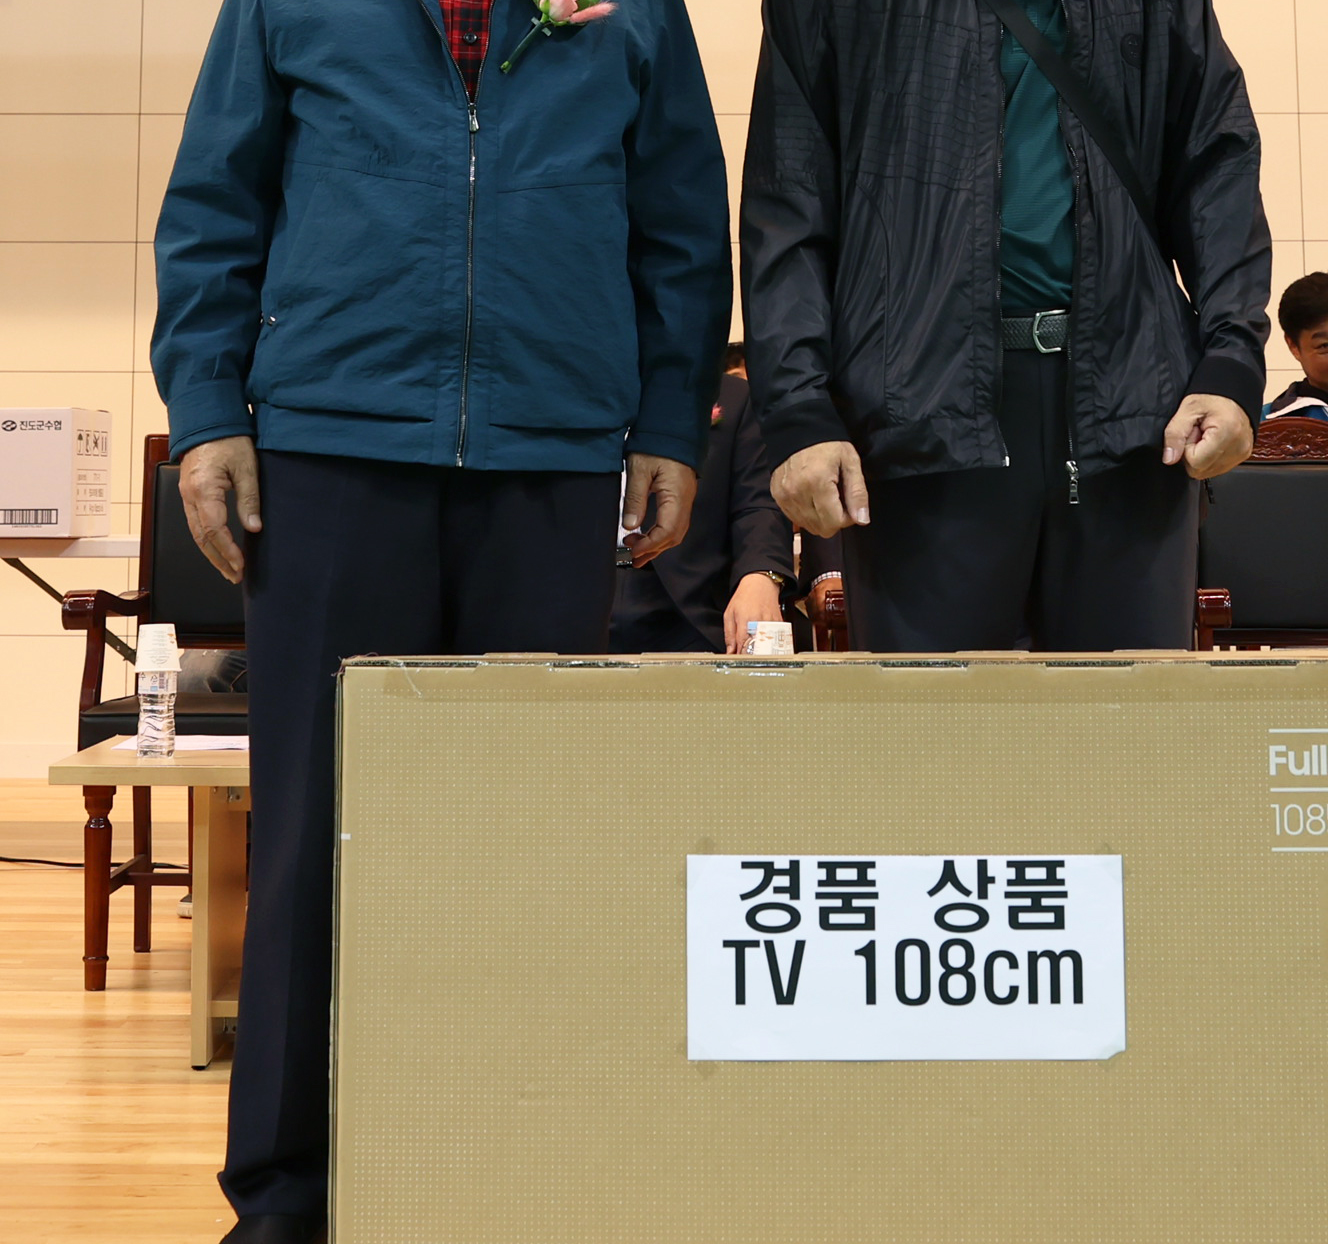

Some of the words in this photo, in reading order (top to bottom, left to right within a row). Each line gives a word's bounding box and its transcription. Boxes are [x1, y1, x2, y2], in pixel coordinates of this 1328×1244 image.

[19, 420, 62, 431] 진도군수협
[1269, 744, 1328, 776] Full
[1270, 803, 1326, 836] 108
[738, 859, 879, 934] 경품
[926, 858, 1068, 933] 상품
[722, 939, 807, 1006] TV
[854, 938, 1084, 1006] 108cm
